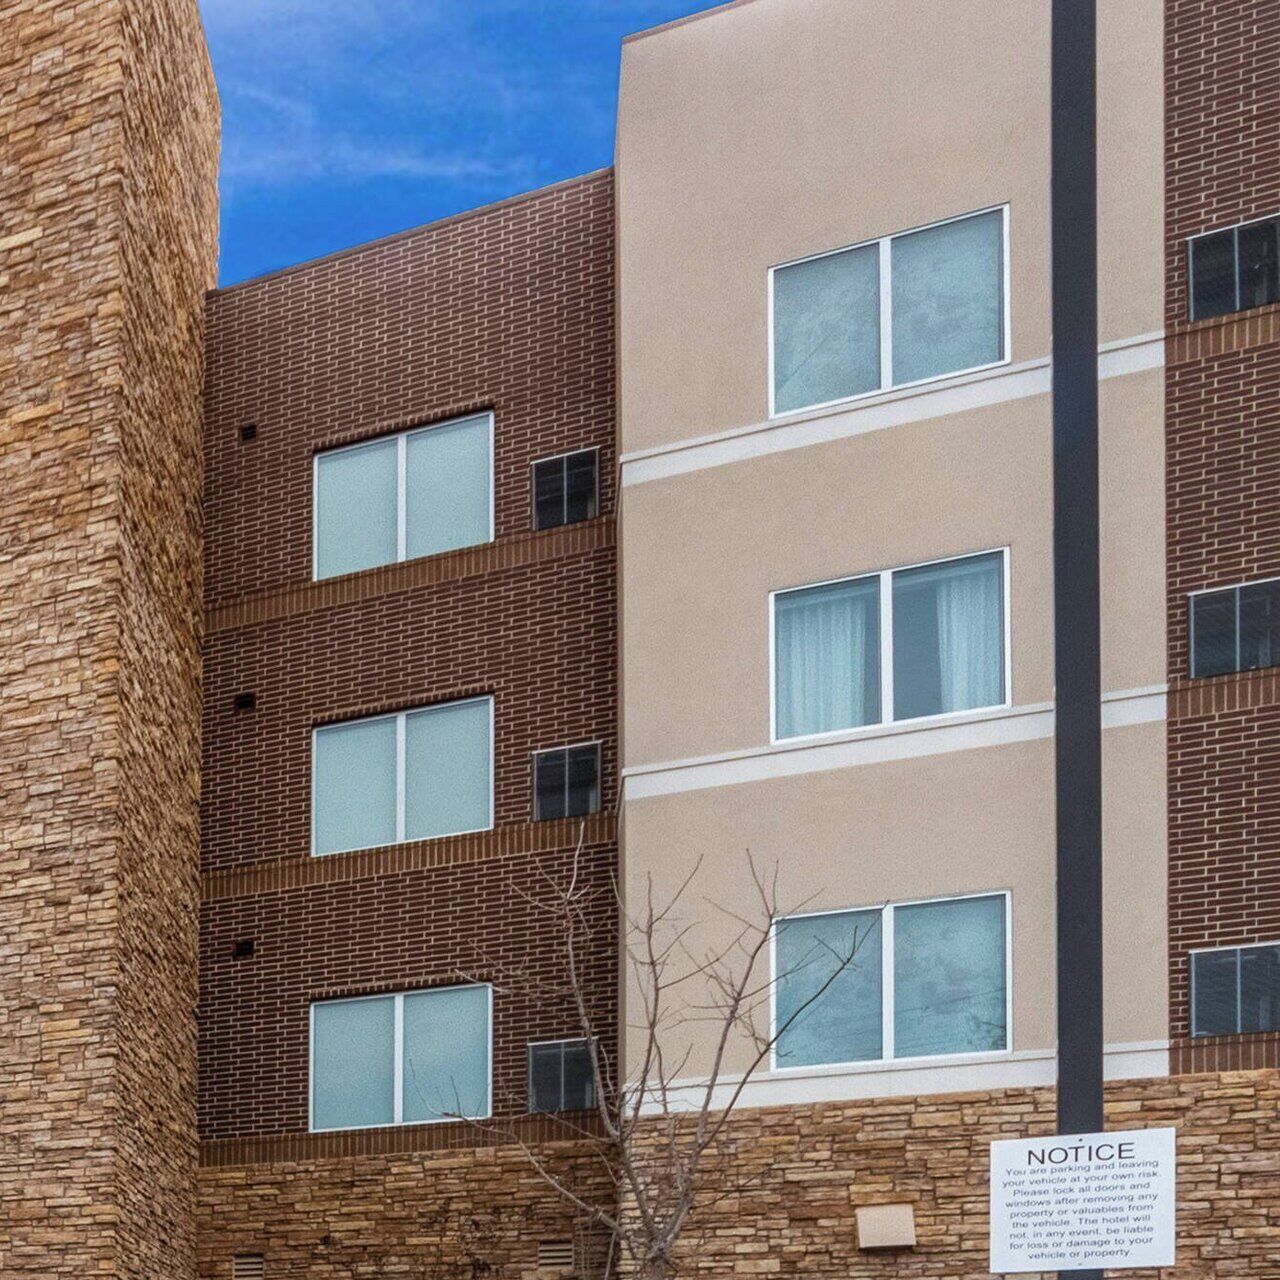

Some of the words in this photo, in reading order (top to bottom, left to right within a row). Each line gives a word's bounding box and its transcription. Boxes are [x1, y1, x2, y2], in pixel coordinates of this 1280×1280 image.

[1027, 1142, 1135, 1165] NOTICE
[1006, 1168, 1026, 1176] You
[1051, 1164, 1090, 1174] parking
[1094, 1162, 1115, 1170] and
[1119, 1159, 1159, 1169] leaving
[1002, 1179, 1025, 1188] your
[1028, 1177, 1067, 1185] vehicle
[1084, 1174, 1108, 1183] your
[1013, 1189, 1049, 1197] Please
[1053, 1187, 1074, 1195] lock
[1078, 1185, 1090, 1193] all
[1094, 1184, 1125, 1192] doors
[1129, 1182, 1151, 1190] and
[1005, 1200, 1051, 1208] windows
[1054, 1197, 1078, 1205] after
[1082, 1193, 1134, 1202] removing
[1138, 1193, 1158, 1201] any
[1010, 1210, 1054, 1219] property
[1072, 1206, 1124, 1214] valuables
[1128, 1204, 1154, 1212] from
[1079, 1217, 1098, 1225] The
[1102, 1216, 1129, 1224] hotel
[1133, 1214, 1151, 1222] will
[1106, 1227, 1120, 1235] be
[1123, 1226, 1154, 1234] liable
[1066, 1239, 1111, 1247] damage
[1128, 1237, 1153, 1246] your
[1028, 1252, 1066, 1260] vehicle
